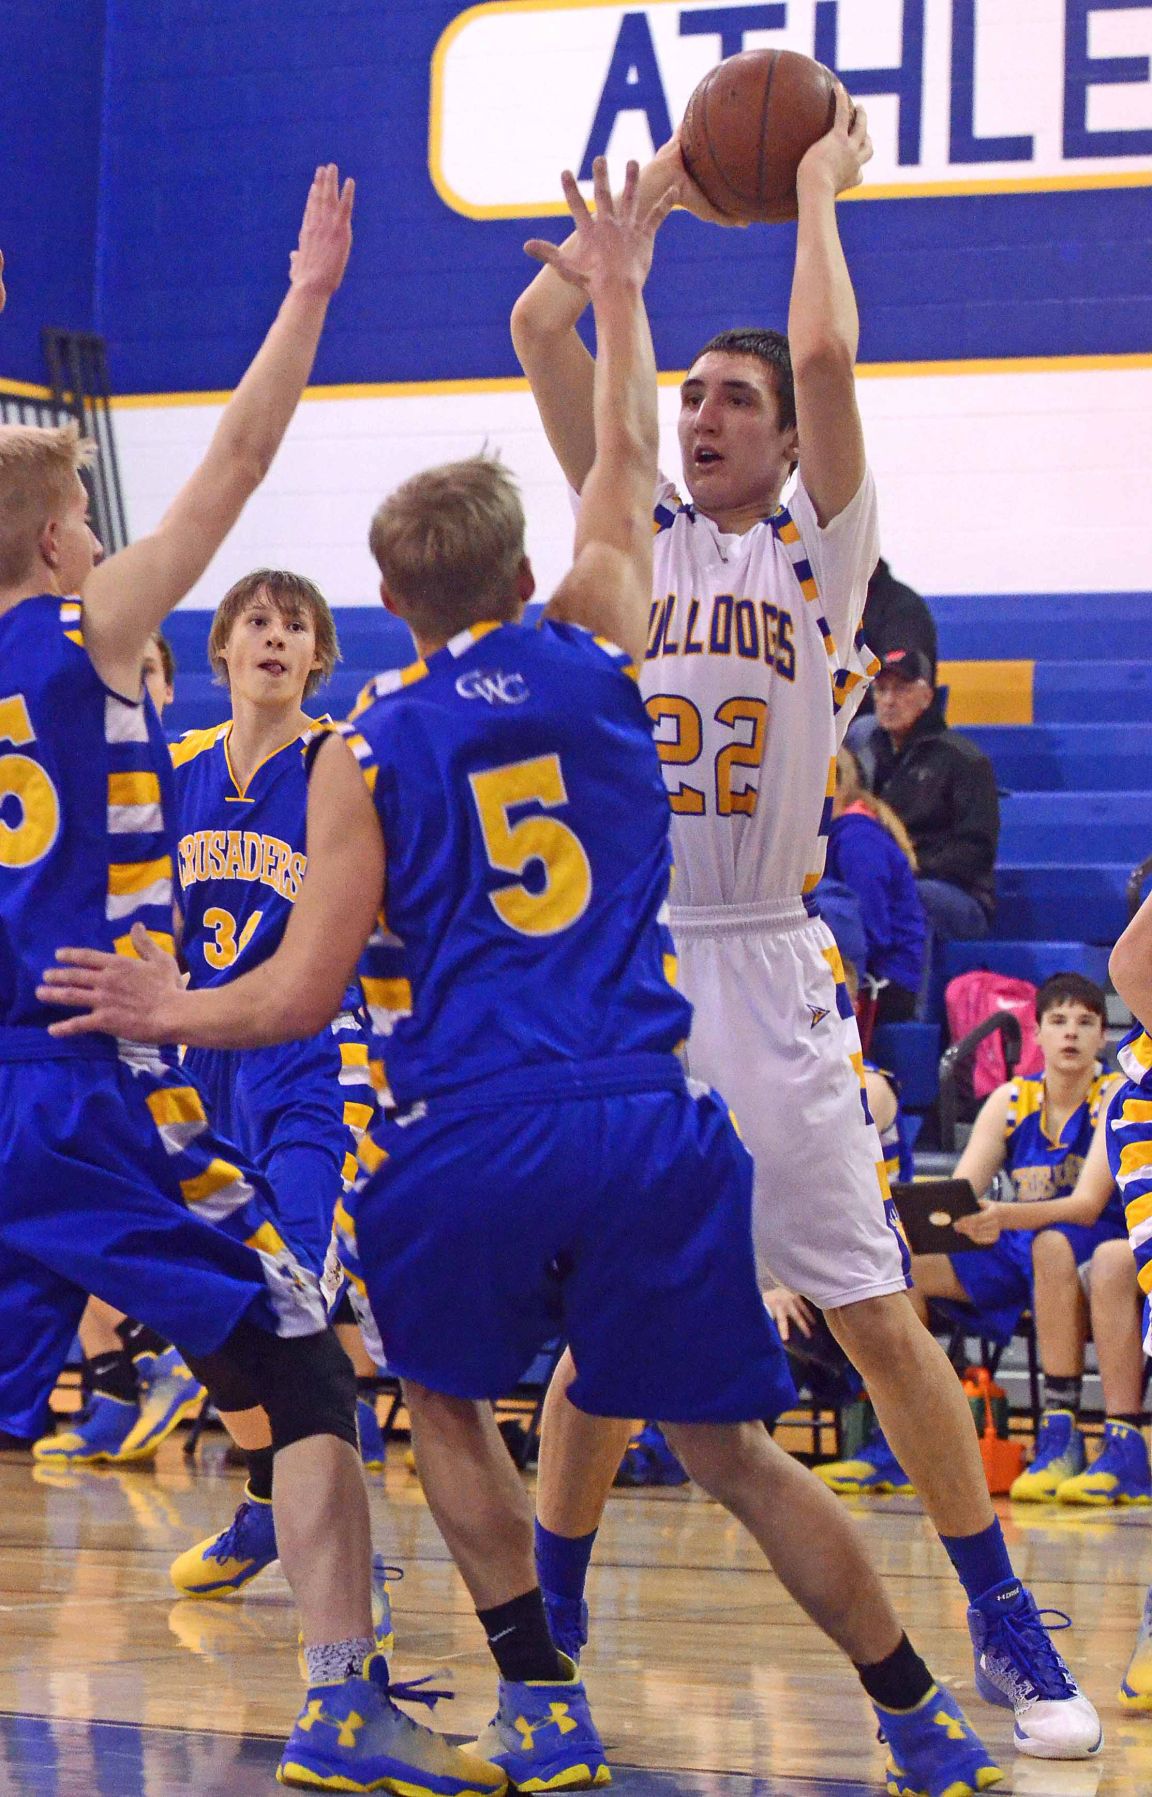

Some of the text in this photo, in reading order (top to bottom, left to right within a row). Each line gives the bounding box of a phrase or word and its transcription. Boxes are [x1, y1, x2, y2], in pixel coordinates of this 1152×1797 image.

[644, 593, 796, 683] ULLDOGS
[644, 693, 770, 817] 22
[468, 752, 592, 937] 5
